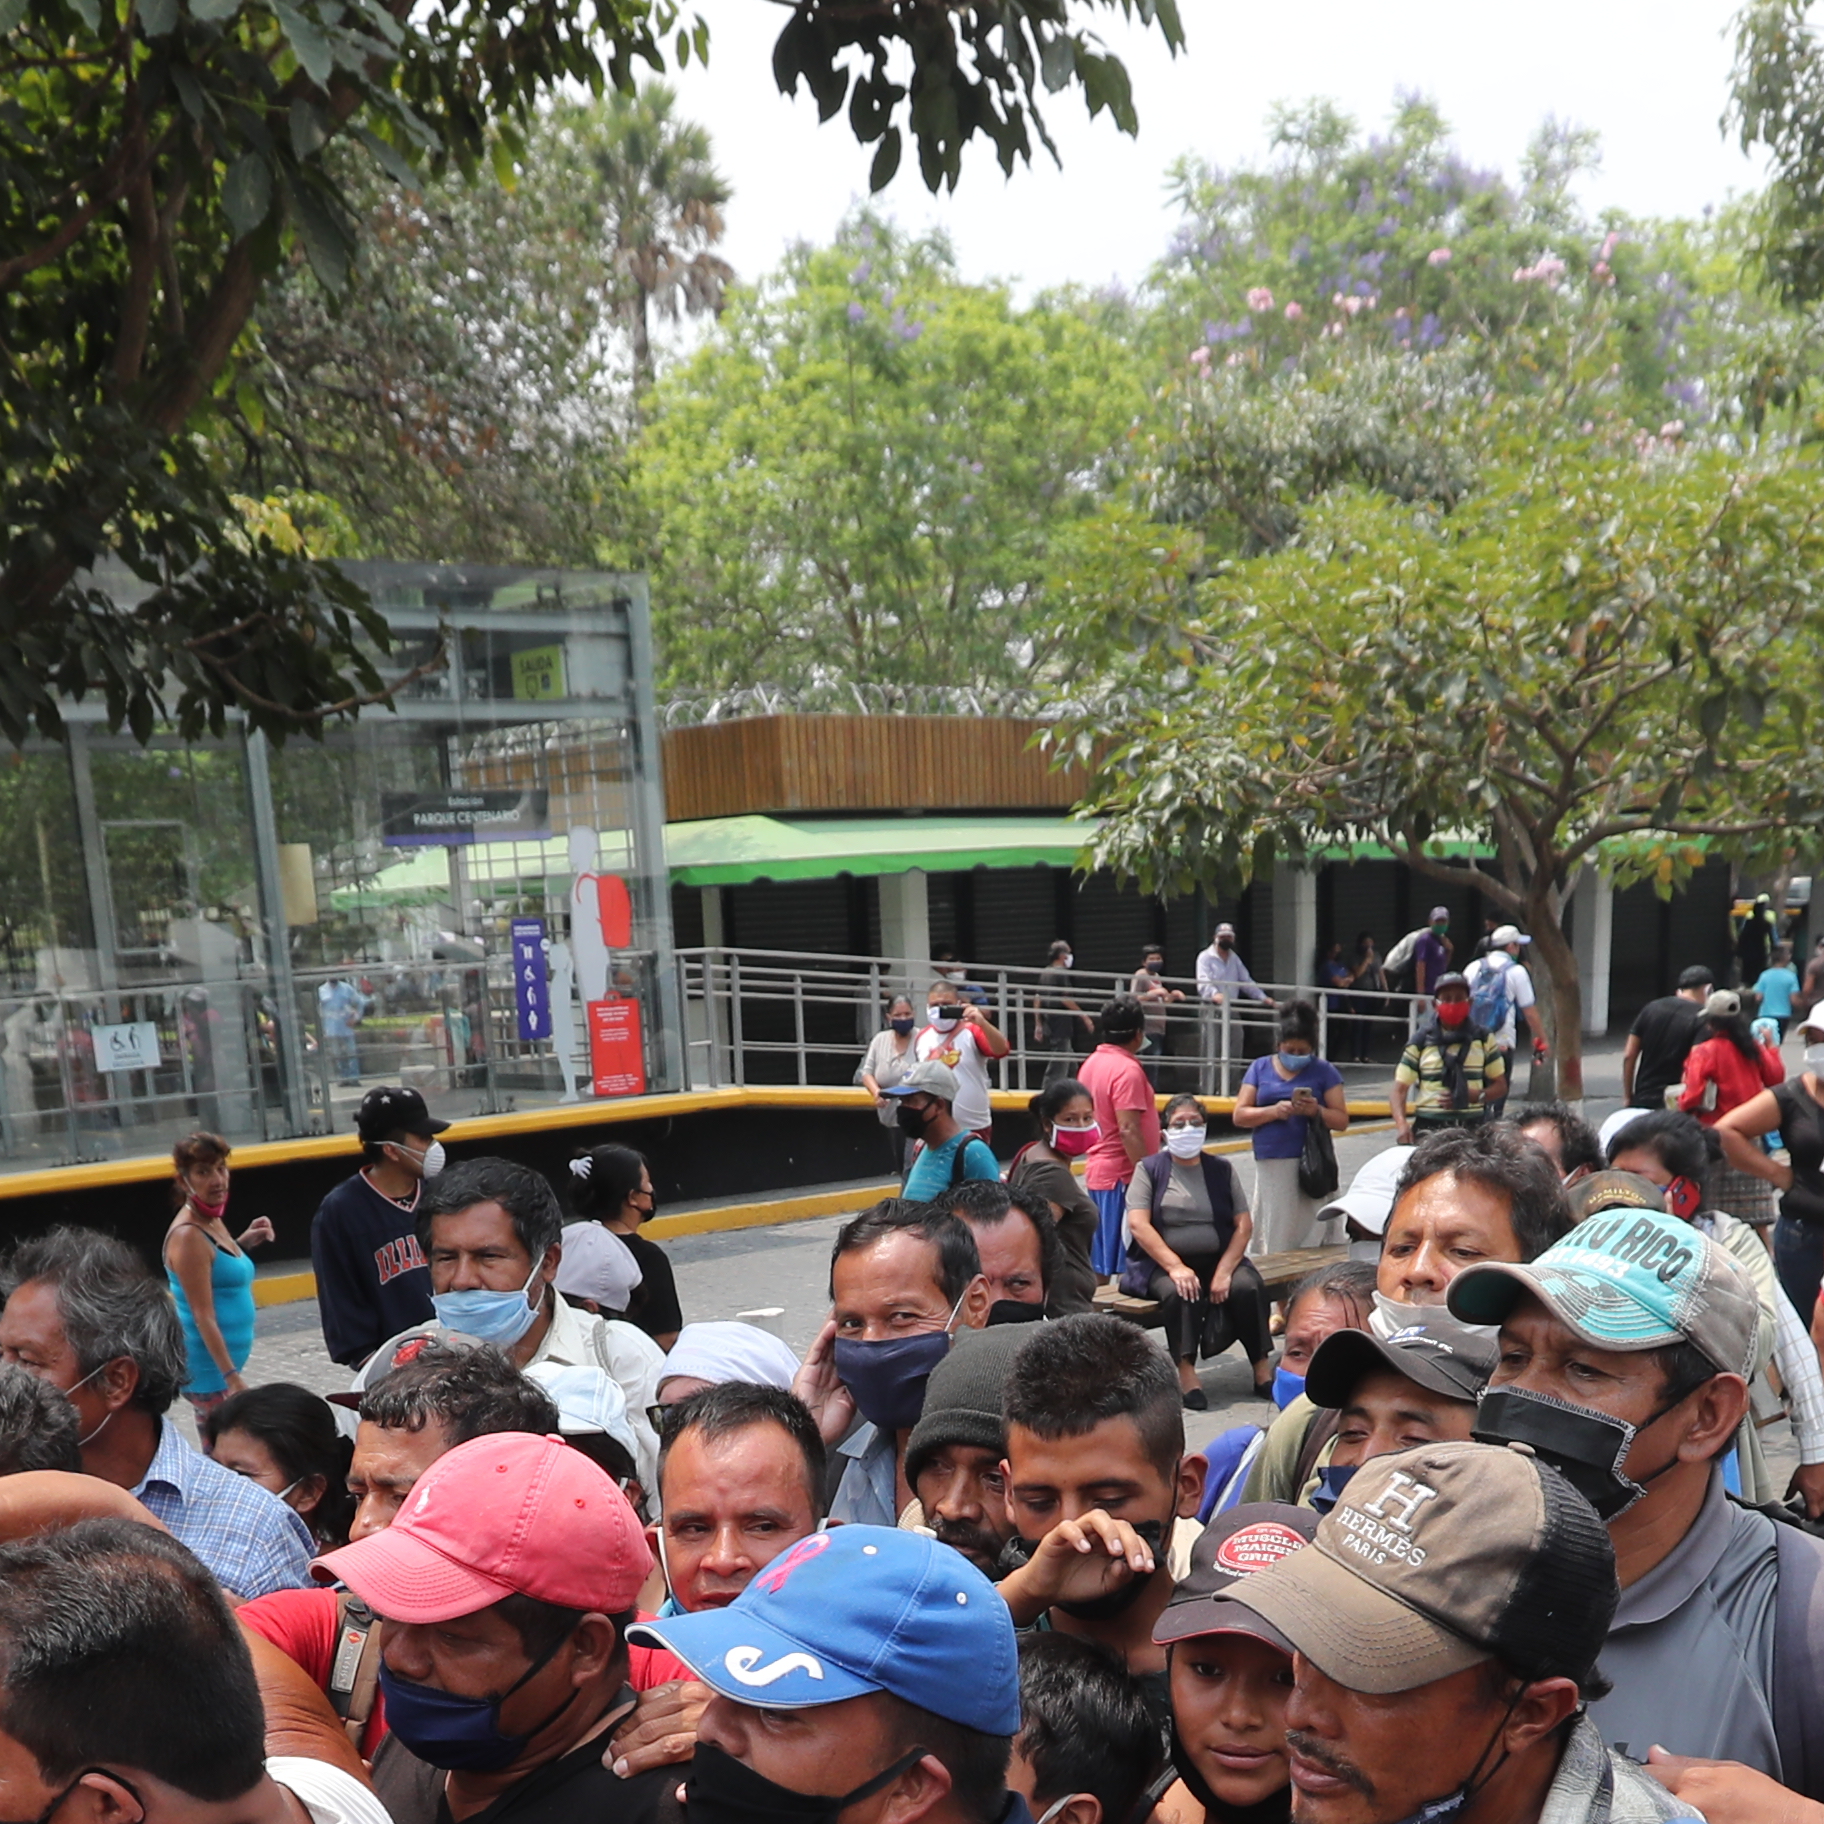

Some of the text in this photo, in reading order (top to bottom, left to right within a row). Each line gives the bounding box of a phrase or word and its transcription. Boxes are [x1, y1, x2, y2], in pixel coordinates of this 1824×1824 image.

[413, 809, 519, 826] PARQUE CENTENARIO
[1609, 1217, 1693, 1283] RICO
[1364, 1471, 1438, 1535] H
[1342, 1533, 1387, 1565] PARIS
